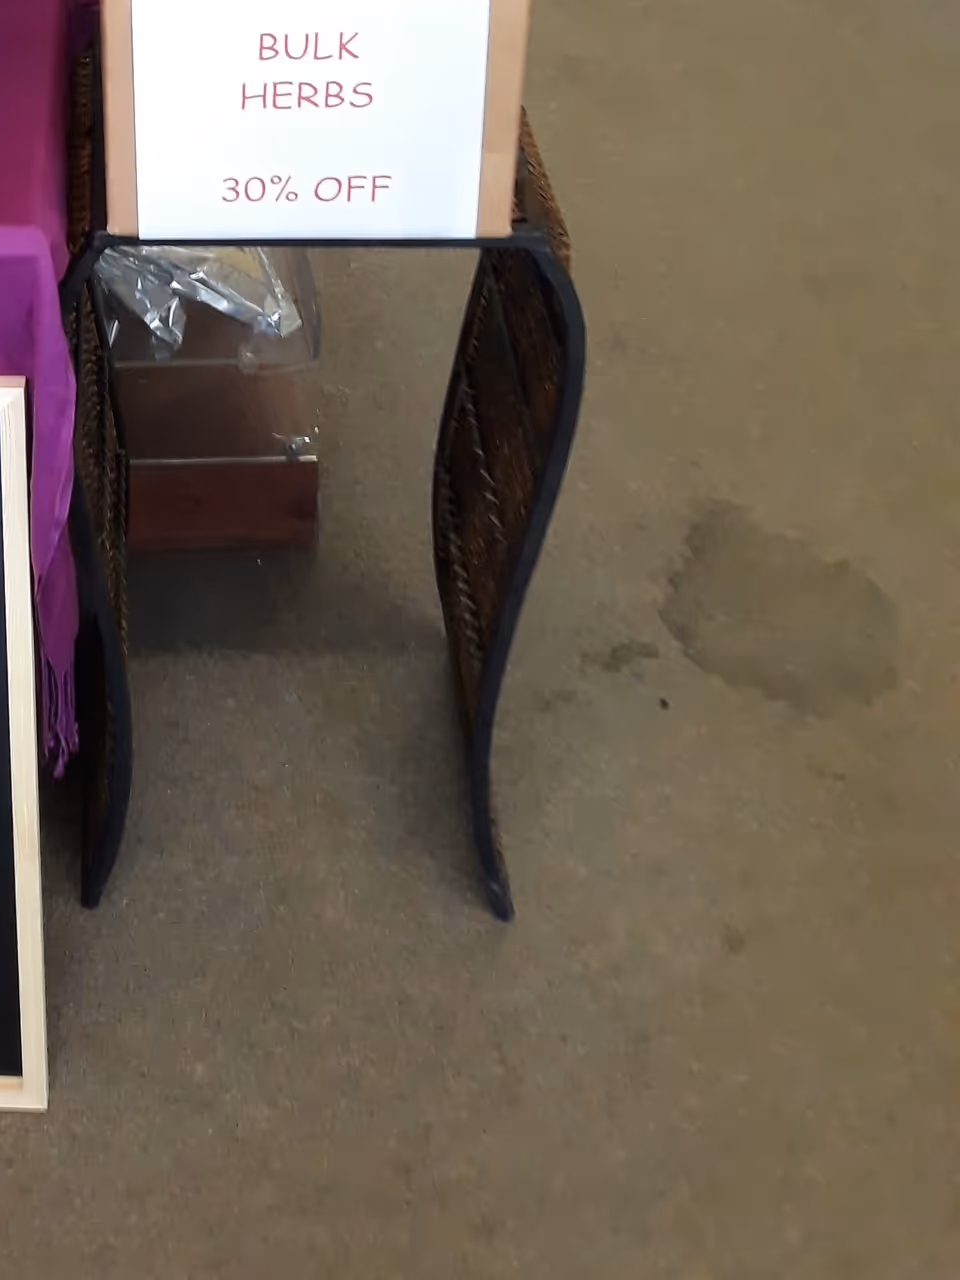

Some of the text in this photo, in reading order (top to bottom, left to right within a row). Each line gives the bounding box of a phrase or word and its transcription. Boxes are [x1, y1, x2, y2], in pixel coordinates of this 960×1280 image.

[258, 32, 359, 61] BULK
[241, 81, 373, 110] HERBS
[221, 175, 392, 202] 30% OFF
